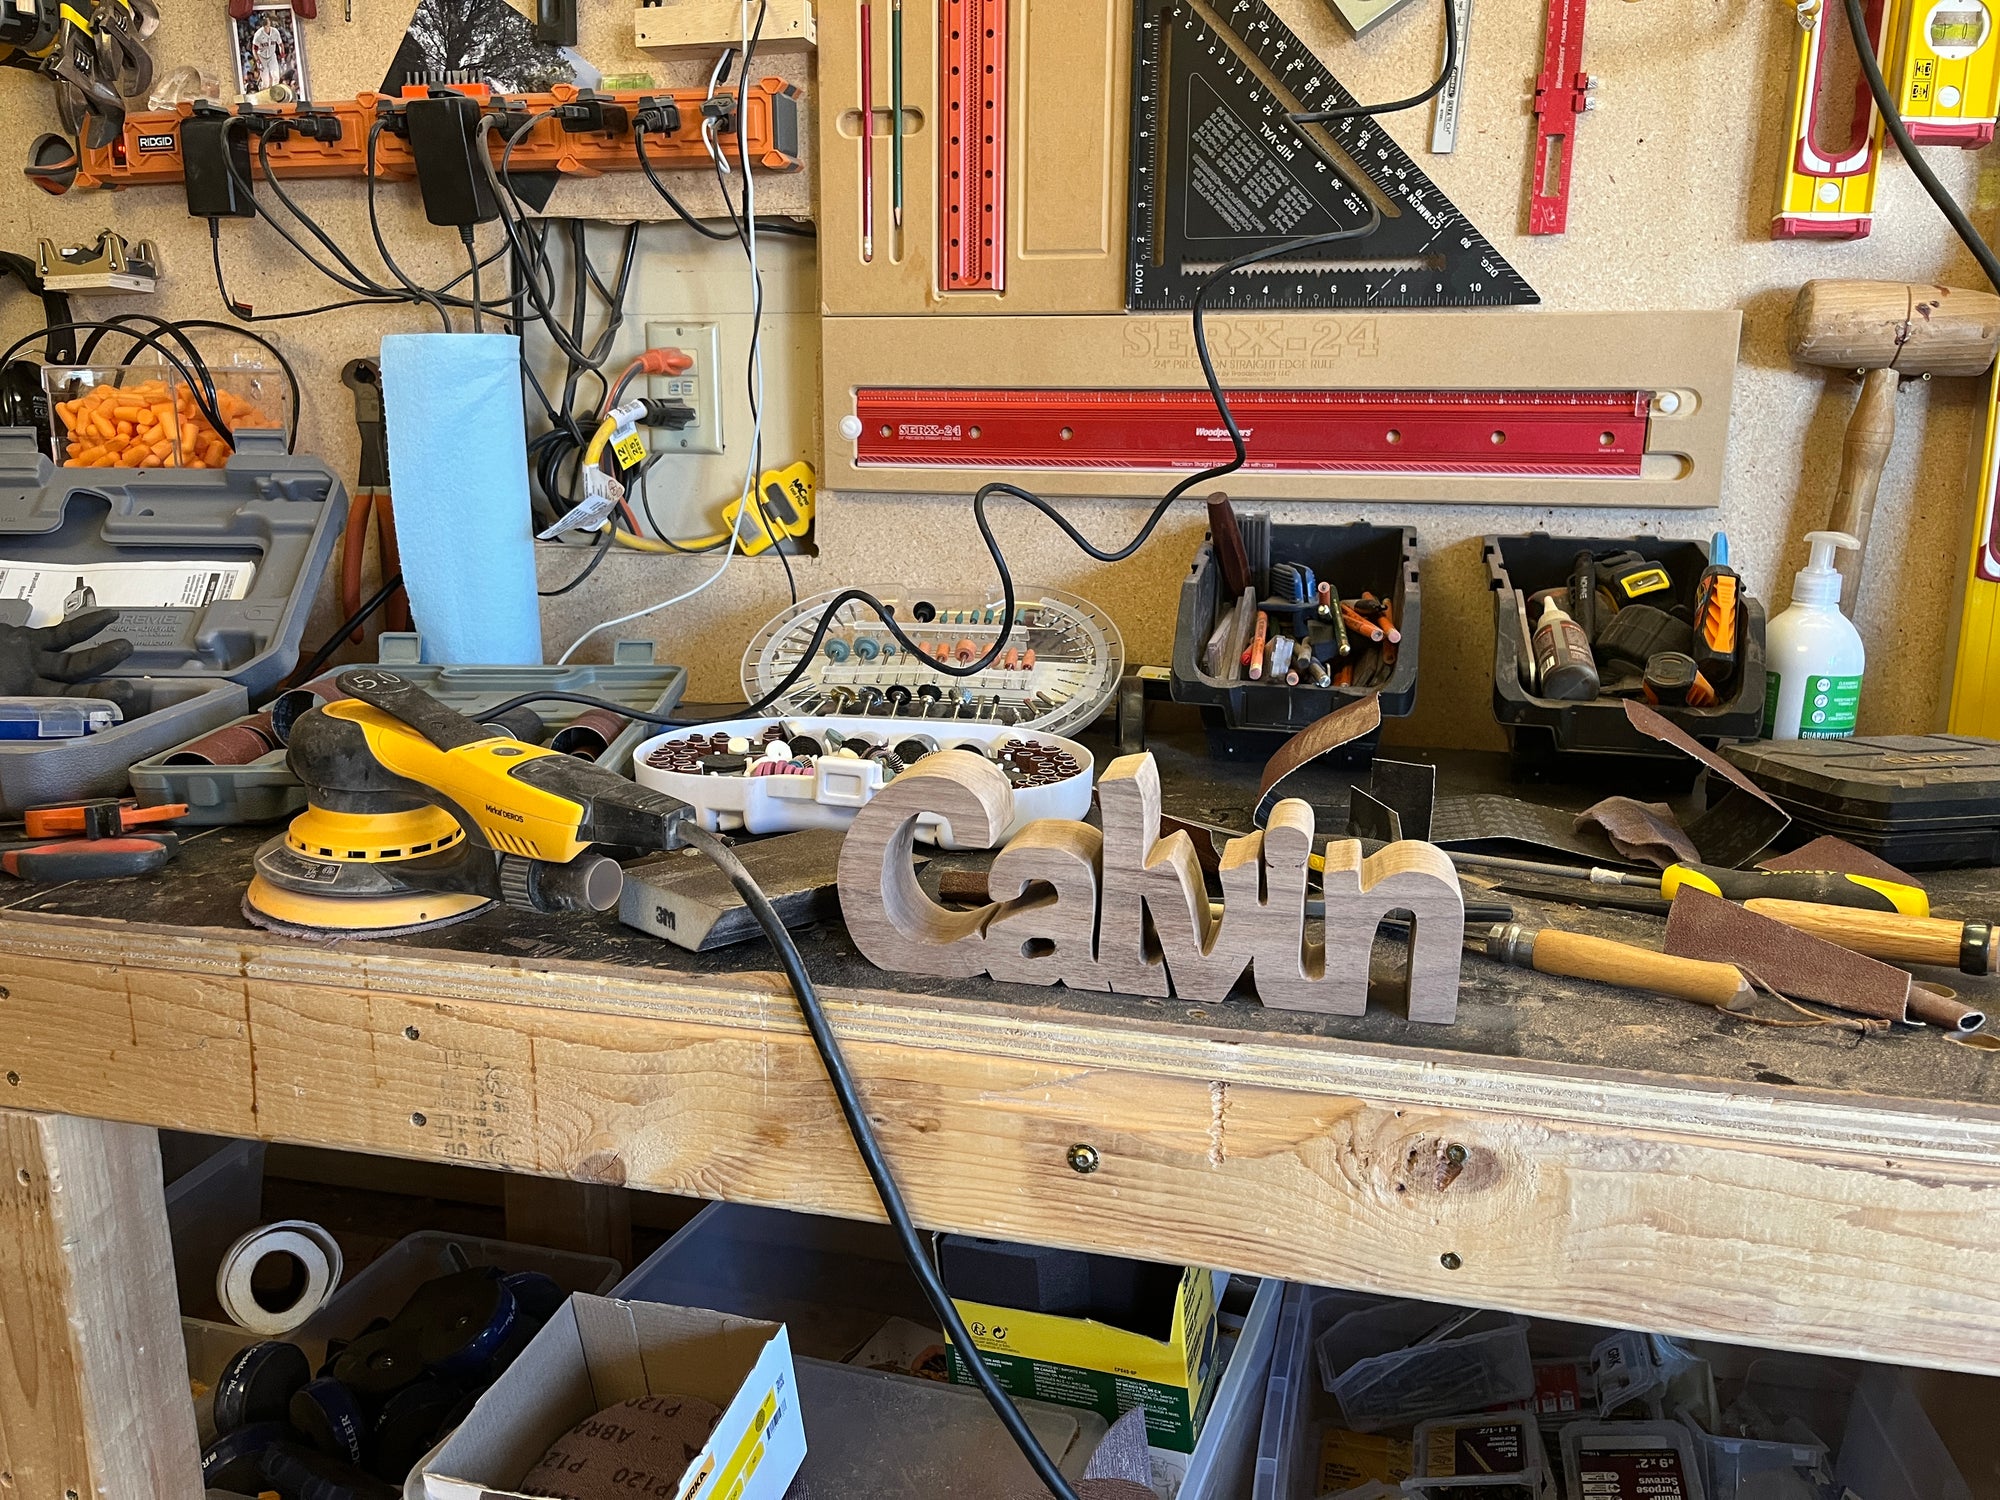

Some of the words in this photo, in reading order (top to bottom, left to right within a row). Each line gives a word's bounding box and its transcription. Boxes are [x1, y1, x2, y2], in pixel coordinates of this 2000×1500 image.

[1239, 0, 1250, 12] 20
[1173, 8, 1181, 17] 2
[1258, 21, 1269, 32] 25
[1262, 38, 1270, 46] 6
[1276, 40, 1287, 52] 30
[1208, 46, 1216, 54] 5
[1293, 59, 1305, 70] 35
[1310, 77, 1320, 88] 40
[1304, 83, 1315, 94] 10
[1249, 91, 1260, 101] 10
[1327, 94, 1337, 105] 45
[1262, 105, 1273, 116] 12
[1321, 100, 1332, 111] 12
[1340, 122, 1351, 133] 15
[1260, 122, 1295, 161] HIP-VAL
[1360, 130, 1371, 142] 55
[139, 136, 173, 148] RIDGID
[1357, 140, 1368, 150] 18
[1377, 149, 1388, 160] 60
[1314, 161, 1326, 172] 24
[1382, 165, 1393, 177] 24
[1395, 168, 1407, 180] 65
[1331, 179, 1342, 190] 30
[1398, 183, 1410, 195] 30
[1415, 189, 1426, 200] 70
[1344, 198, 1360, 215] TOP
[1406, 193, 1442, 230] COMMON
[1436, 212, 1448, 224] 75
[1460, 238, 1472, 249] 80
[1481, 256, 1499, 278] DEG.
[1135, 263, 1144, 294] PIVOT
[1297, 286, 1302, 294] 5
[1331, 285, 1337, 293] 6
[1469, 283, 1482, 292] 10
[1122, 319, 1379, 358] SERX-24
[1230, 360, 1275, 369] STRAIGHT
[1280, 360, 1305, 369] EDGE
[1310, 360, 1335, 369] RULE
[898, 424, 961, 436] SERX-24
[631, 442, 639, 456] 25
[620, 449, 628, 464] 12
[503, 810, 524, 822] DEROS
[838, 750, 1464, 1025] Calvin
[656, 906, 676, 931] 3M
[1608, 1348, 1621, 1368] GRK
[1636, 1458, 1649, 1469] 2"
[612, 1467, 676, 1497] P120
[1636, 1486, 1680, 1494] Purpose
